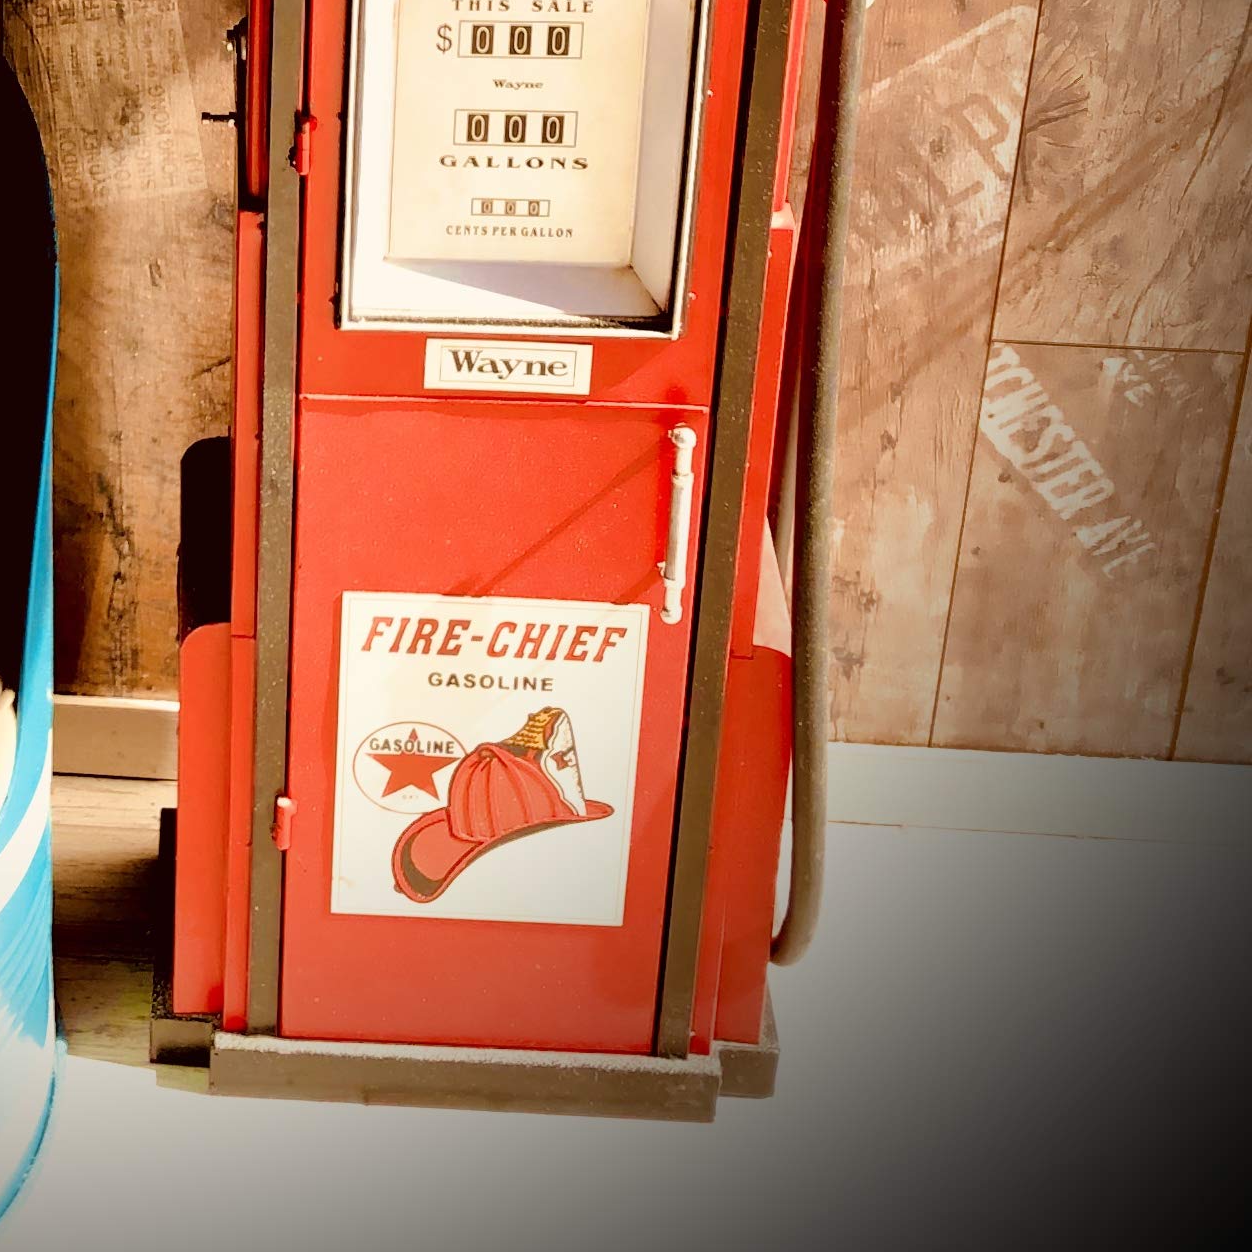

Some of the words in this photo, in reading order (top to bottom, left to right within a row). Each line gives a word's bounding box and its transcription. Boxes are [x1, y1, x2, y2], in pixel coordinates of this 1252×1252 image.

[531, 0, 595, 14] SALE
[493, 78, 544, 90] Wayne
[470, 114, 562, 143] 000
[439, 154, 589, 170] GALLONS
[446, 224, 488, 236] CENTS
[492, 226, 517, 237] PER
[520, 227, 574, 238] GALLON
[450, 348, 568, 381] Wayne
[360, 615, 628, 663] FIRE-CHIEF
[427, 671, 555, 692] GASOLINE
[369, 737, 456, 755] GASOLINE
